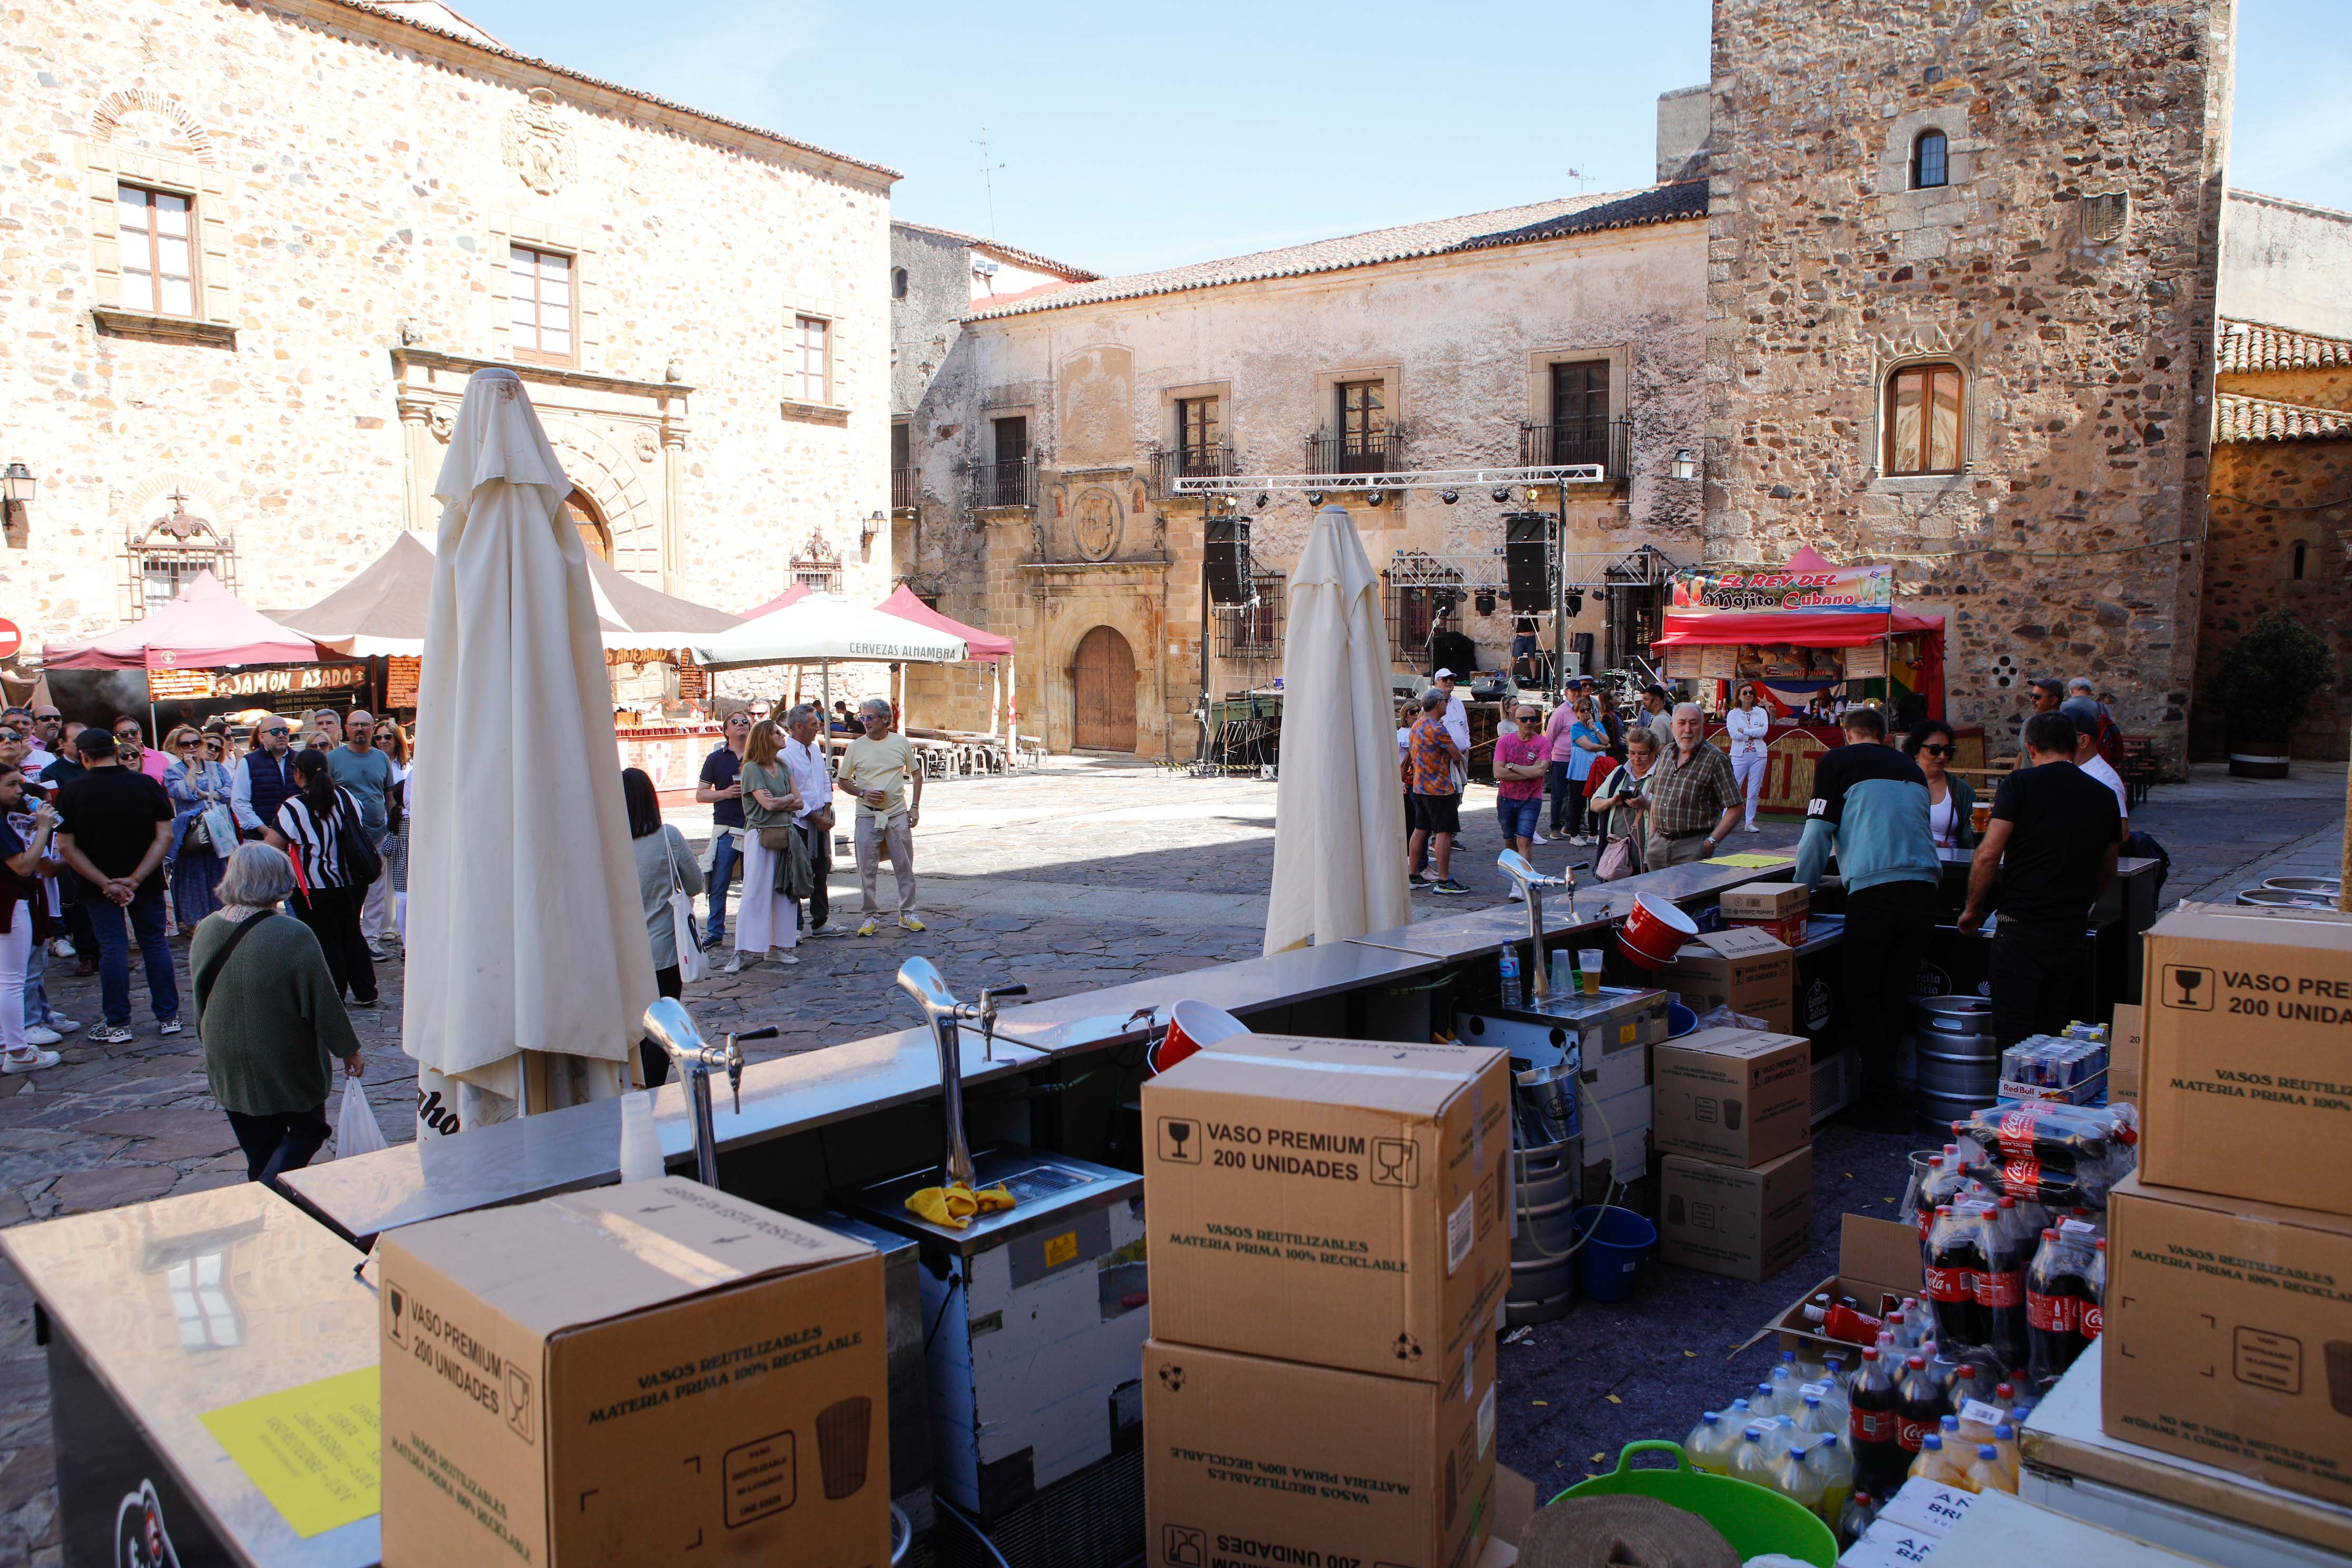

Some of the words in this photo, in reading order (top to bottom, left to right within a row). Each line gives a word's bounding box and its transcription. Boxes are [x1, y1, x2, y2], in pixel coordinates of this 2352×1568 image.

[1719, 574, 1742, 588] EL
[1750, 573, 1795, 588] REY
[1797, 573, 1838, 586] DEL
[1703, 593, 1774, 611] Mojito
[1782, 592, 1854, 610] Cubano
[849, 642, 898, 656] CERVEZAS
[903, 645, 955, 660] ALHAMBRA
[228, 671, 291, 695] JAMÓN
[301, 669, 351, 688] ASADO
[2222, 970, 2290, 993] VASO
[2298, 978, 2352, 999] PRE
[2229, 997, 2269, 1016] 200
[2130, 1035, 2140, 1044] 20
[1762, 1064, 1775, 1074] VASO
[2216, 1069, 2273, 1086] VASOS
[2004, 1084, 2018, 1093] Red
[2020, 1086, 2034, 1095] Bull
[2169, 1079, 2246, 1097] MATERIA
[2251, 1089, 2307, 1106] PRIMA
[2312, 1098, 2351, 1111] 100%
[1207, 1123, 1261, 1144] VASO
[1268, 1128, 1366, 1155] PREMIUM
[1214, 1150, 1246, 1169] 200
[1253, 1154, 1359, 1181] UNIDADES
[1207, 1223, 1252, 1238] VASOS
[1257, 1230, 1369, 1253] REUTILIZABLES
[1170, 1233, 1231, 1251] MATERIA
[1236, 1242, 1281, 1257] PRIMA
[1286, 1249, 1316, 1262] 100%
[1320, 1253, 1409, 1273] RECICLABLE
[2168, 1244, 2216, 1261] VASOS
[2219, 1255, 2336, 1286] REUTILIZABLES
[2131, 1249, 2193, 1270] MATERIA
[2197, 1263, 2243, 1281] PRIMA
[2248, 1273, 2279, 1288] 100%
[411, 1297, 441, 1338] VASO
[445, 1320, 502, 1381] PREMIUM
[638, 1363, 695, 1390] VASOS
[700, 1326, 824, 1372] REUTILIZABLES
[414, 1335, 434, 1367] 200
[435, 1352, 500, 1415] UNIDADES
[588, 1390, 670, 1425] MATERIA
[675, 1374, 730, 1398] PRIMA
[734, 1361, 768, 1382] 100%
[772, 1331, 863, 1370] RECICLABLE
[391, 1435, 426, 1474] MATERIA
[427, 1467, 454, 1497] PRIMA
[1171, 1447, 1253, 1471] RECICLABLE
[1257, 1462, 1287, 1476] 100%
[411, 1432, 438, 1464] VASOS
[439, 1454, 508, 1520] REUTILIZABLES
[1207, 1467, 1317, 1496] REUTILIZABLES
[1292, 1467, 1339, 1484] PRIMA
[1342, 1475, 1412, 1495] MATERIA
[1320, 1486, 1370, 1504] VASOS
[1217, 1535, 1321, 1568] UNIDADES
